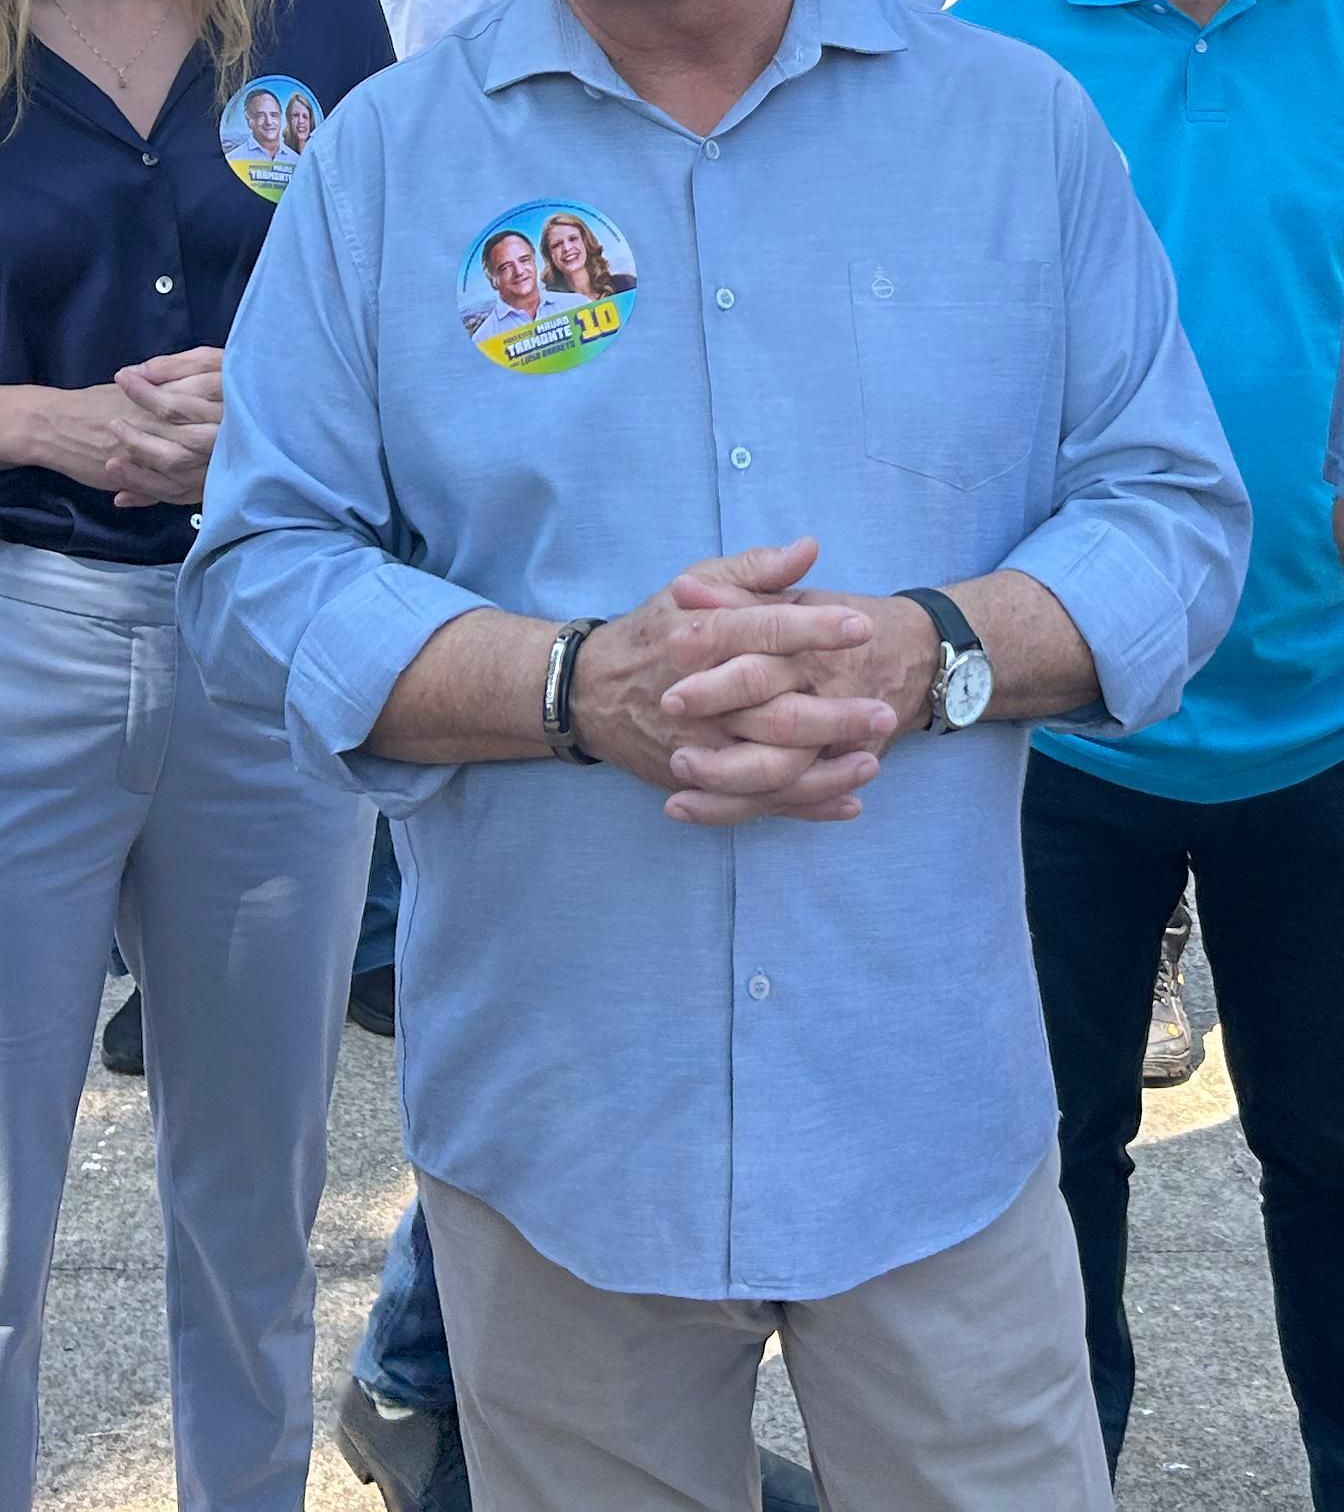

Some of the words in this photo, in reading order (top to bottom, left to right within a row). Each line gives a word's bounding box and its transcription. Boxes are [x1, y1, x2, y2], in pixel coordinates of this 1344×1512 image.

[505, 325, 574, 359] TRAMONTE
[574, 300, 622, 344] 10
[535, 315, 570, 336] MAURO
